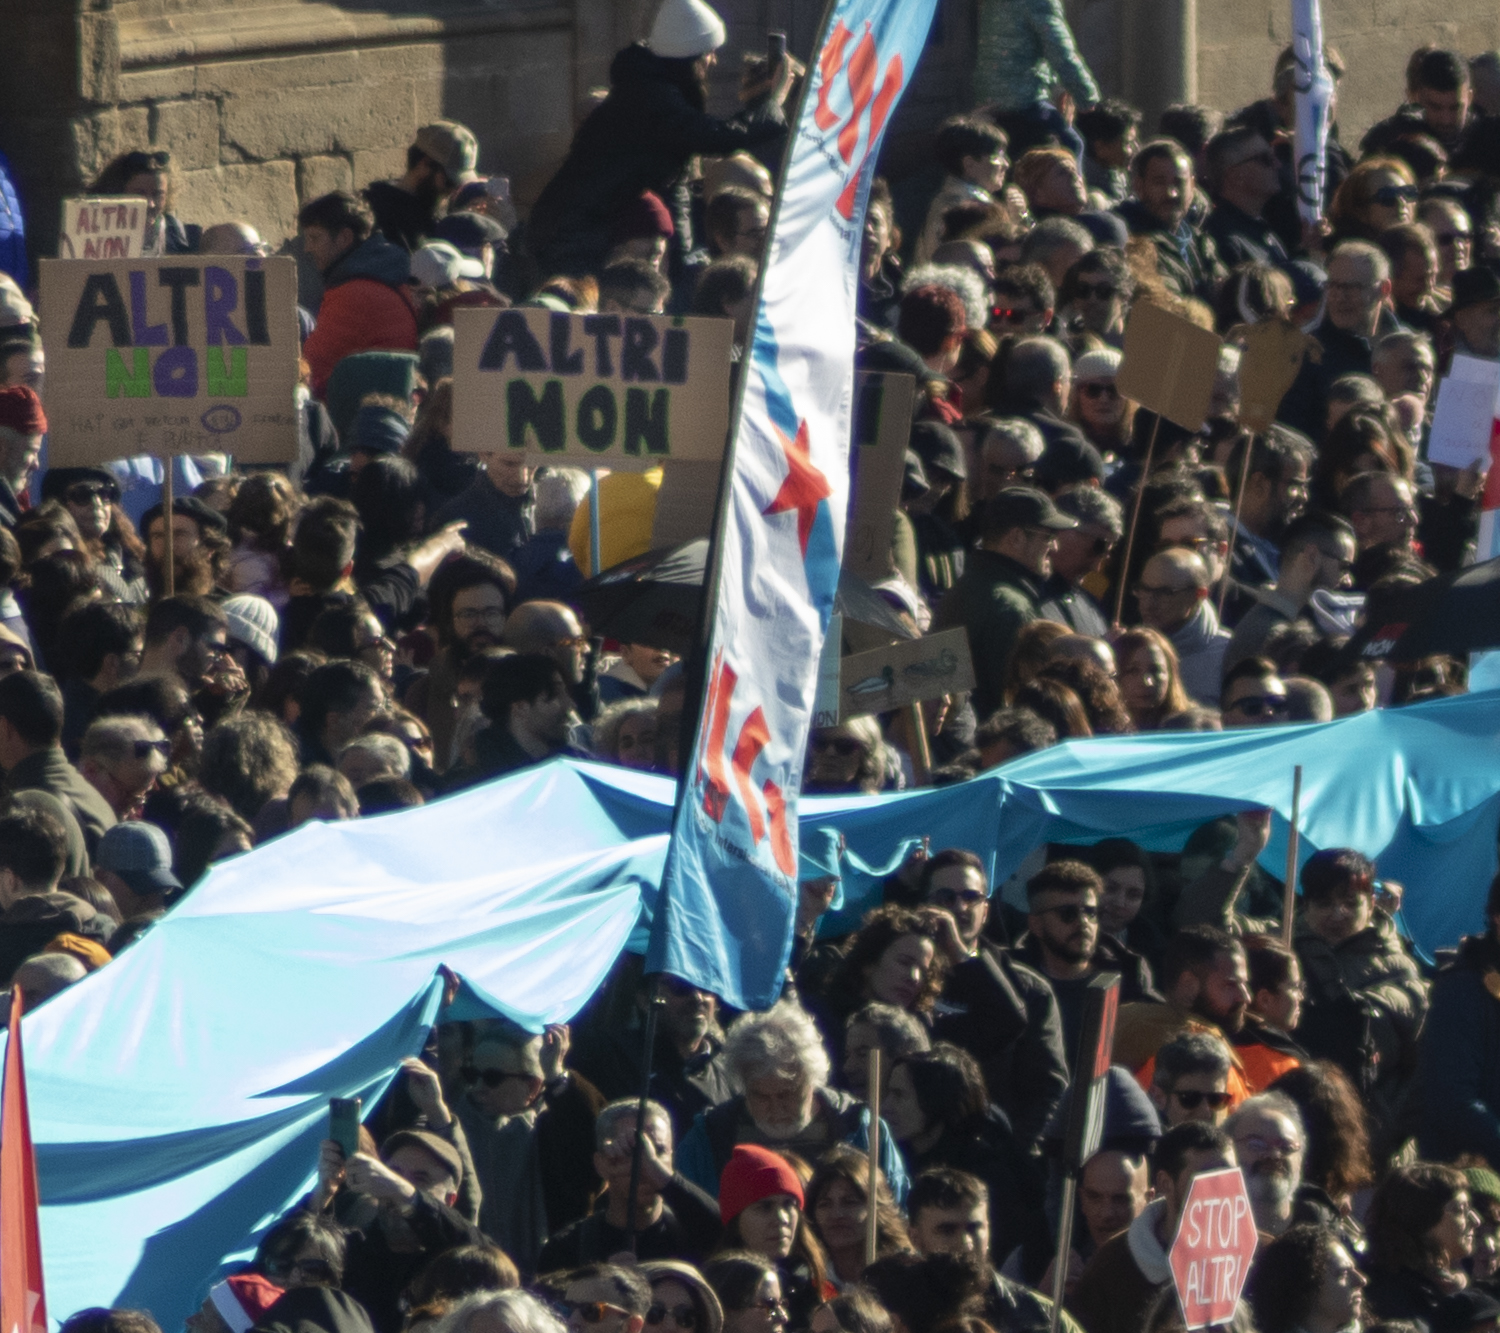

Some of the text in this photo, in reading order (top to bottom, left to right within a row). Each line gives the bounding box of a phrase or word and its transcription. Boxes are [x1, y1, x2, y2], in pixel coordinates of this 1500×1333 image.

[105, 345, 249, 399] NON
[505, 379, 671, 455] NON
[1187, 1198, 1247, 1250] STOP
[1185, 1254, 1242, 1308] ALTRI
